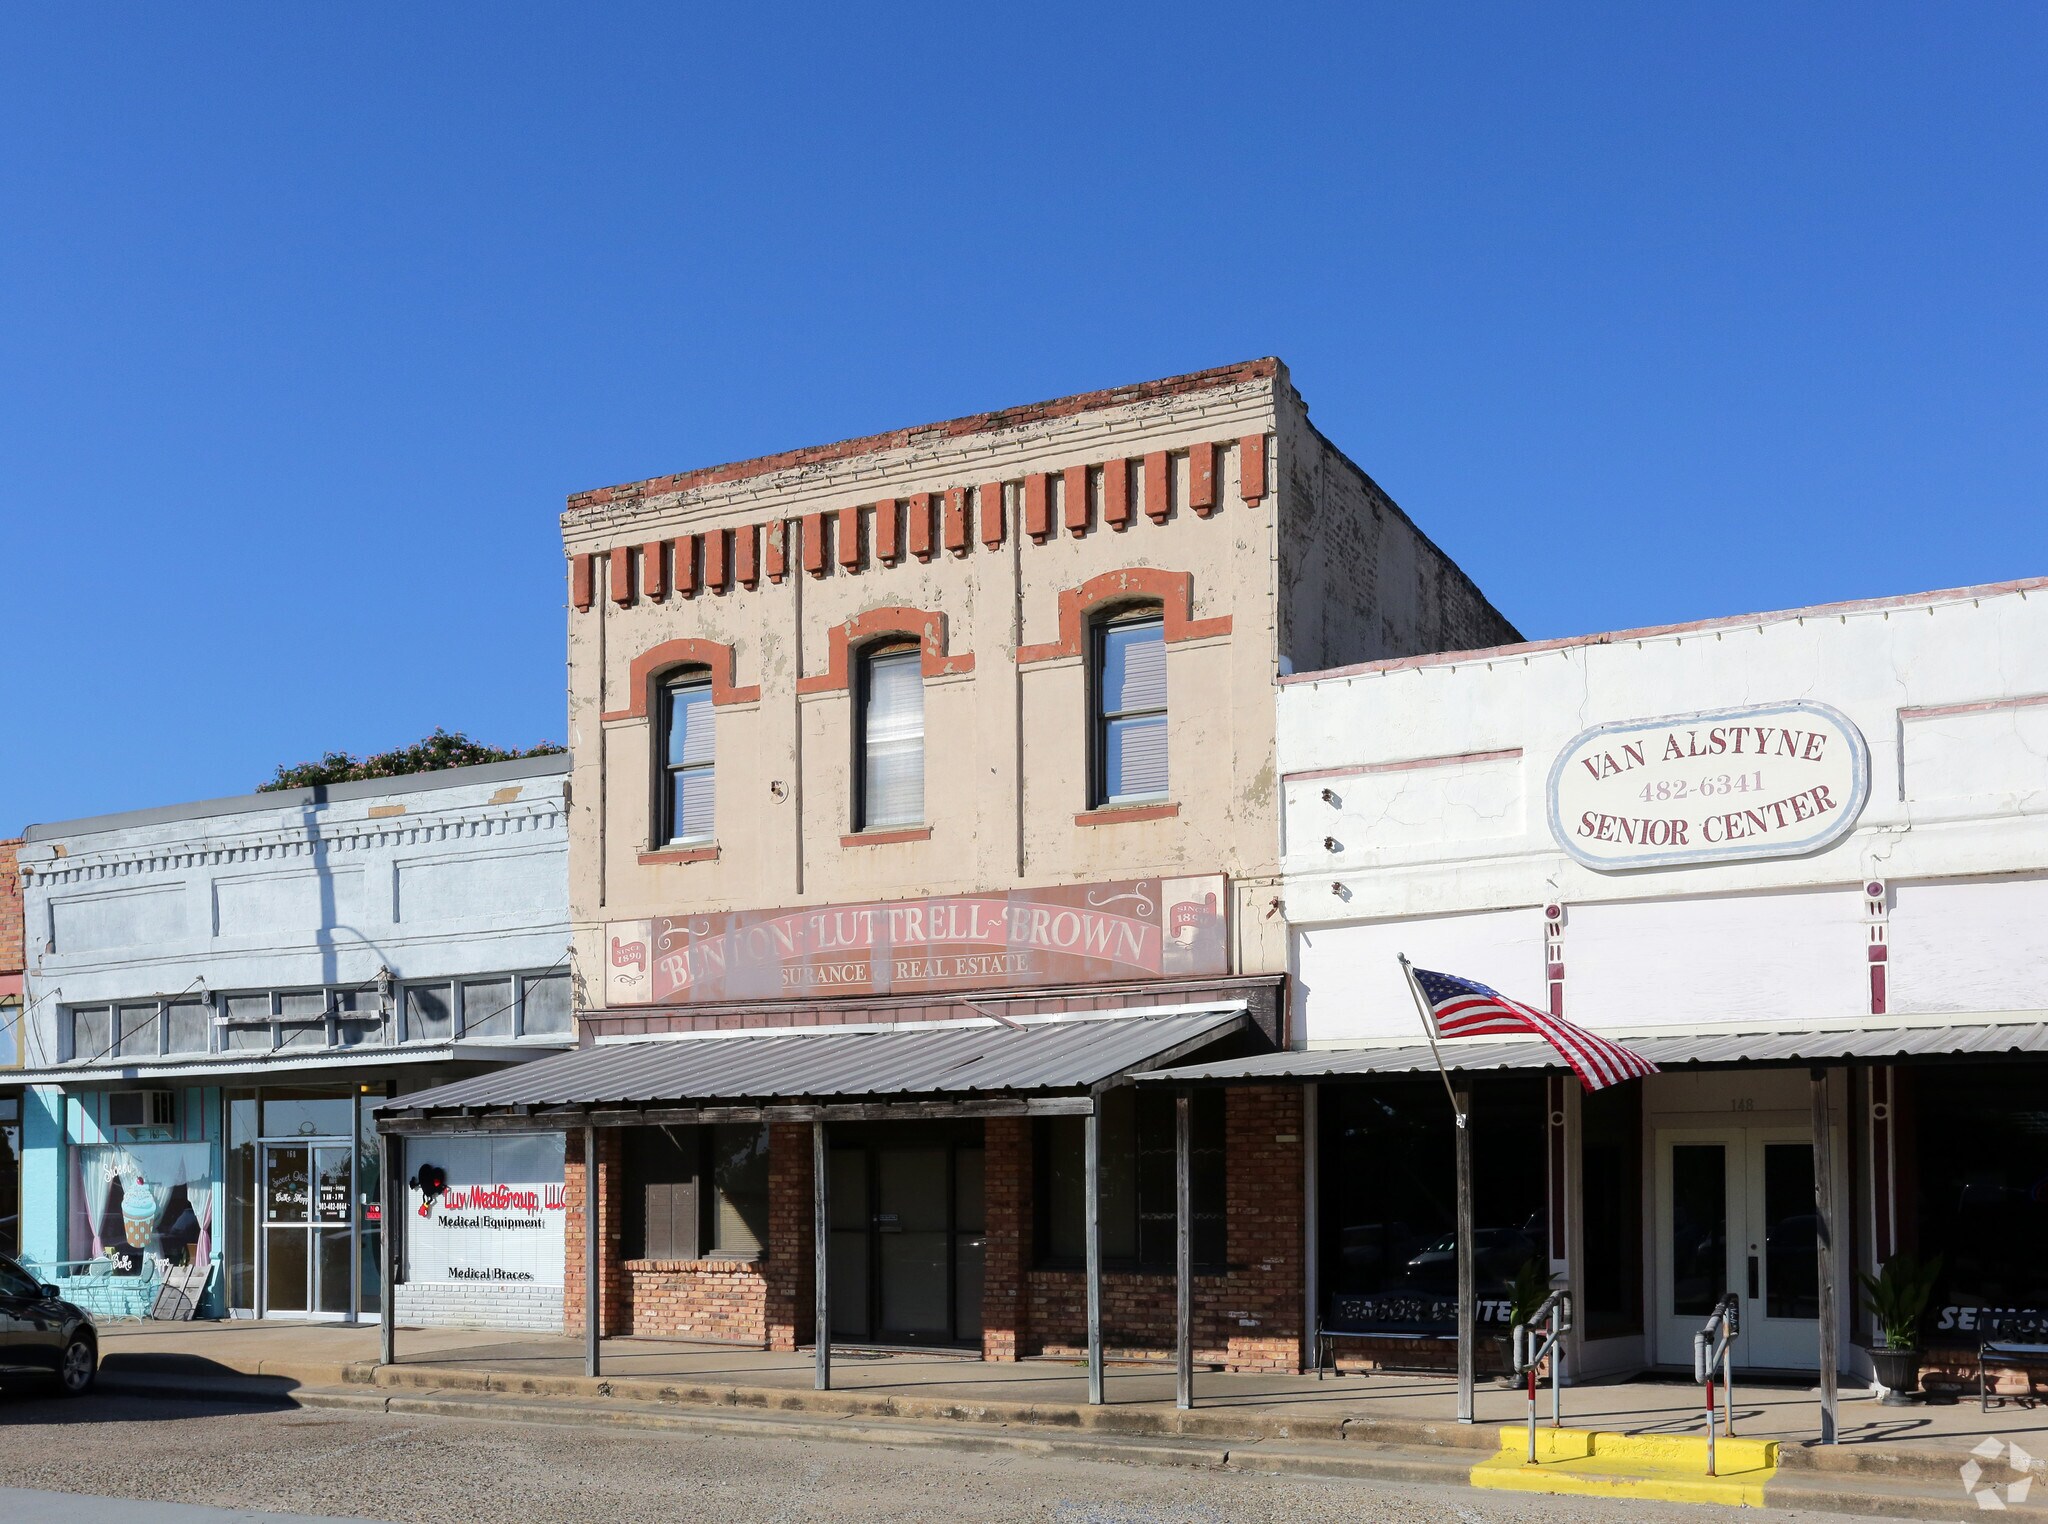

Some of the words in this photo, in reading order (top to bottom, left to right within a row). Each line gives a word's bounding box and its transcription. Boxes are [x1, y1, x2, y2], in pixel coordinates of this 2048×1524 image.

[1581, 740, 1646, 781] VAN
[1661, 727, 1828, 762] ALSTYNE
[1638, 770, 1766, 802] 482-6341
[1577, 810, 1689, 846] SENIOR
[1702, 784, 1837, 843] CENTER
[616, 945, 641, 956] SINCE
[617, 951, 642, 963] 1890
[781, 964, 867, 985] SURANCE
[895, 959, 952, 979] REAL
[955, 953, 1028, 975] ESTATE
[1732, 1098, 1753, 1112] 148
[443, 1187, 467, 1209] Luv
[438, 1216, 480, 1227] Medical
[483, 1216, 542, 1229] Equipment
[448, 1267, 490, 1278] Medical
[494, 1268, 531, 1280] Braces
